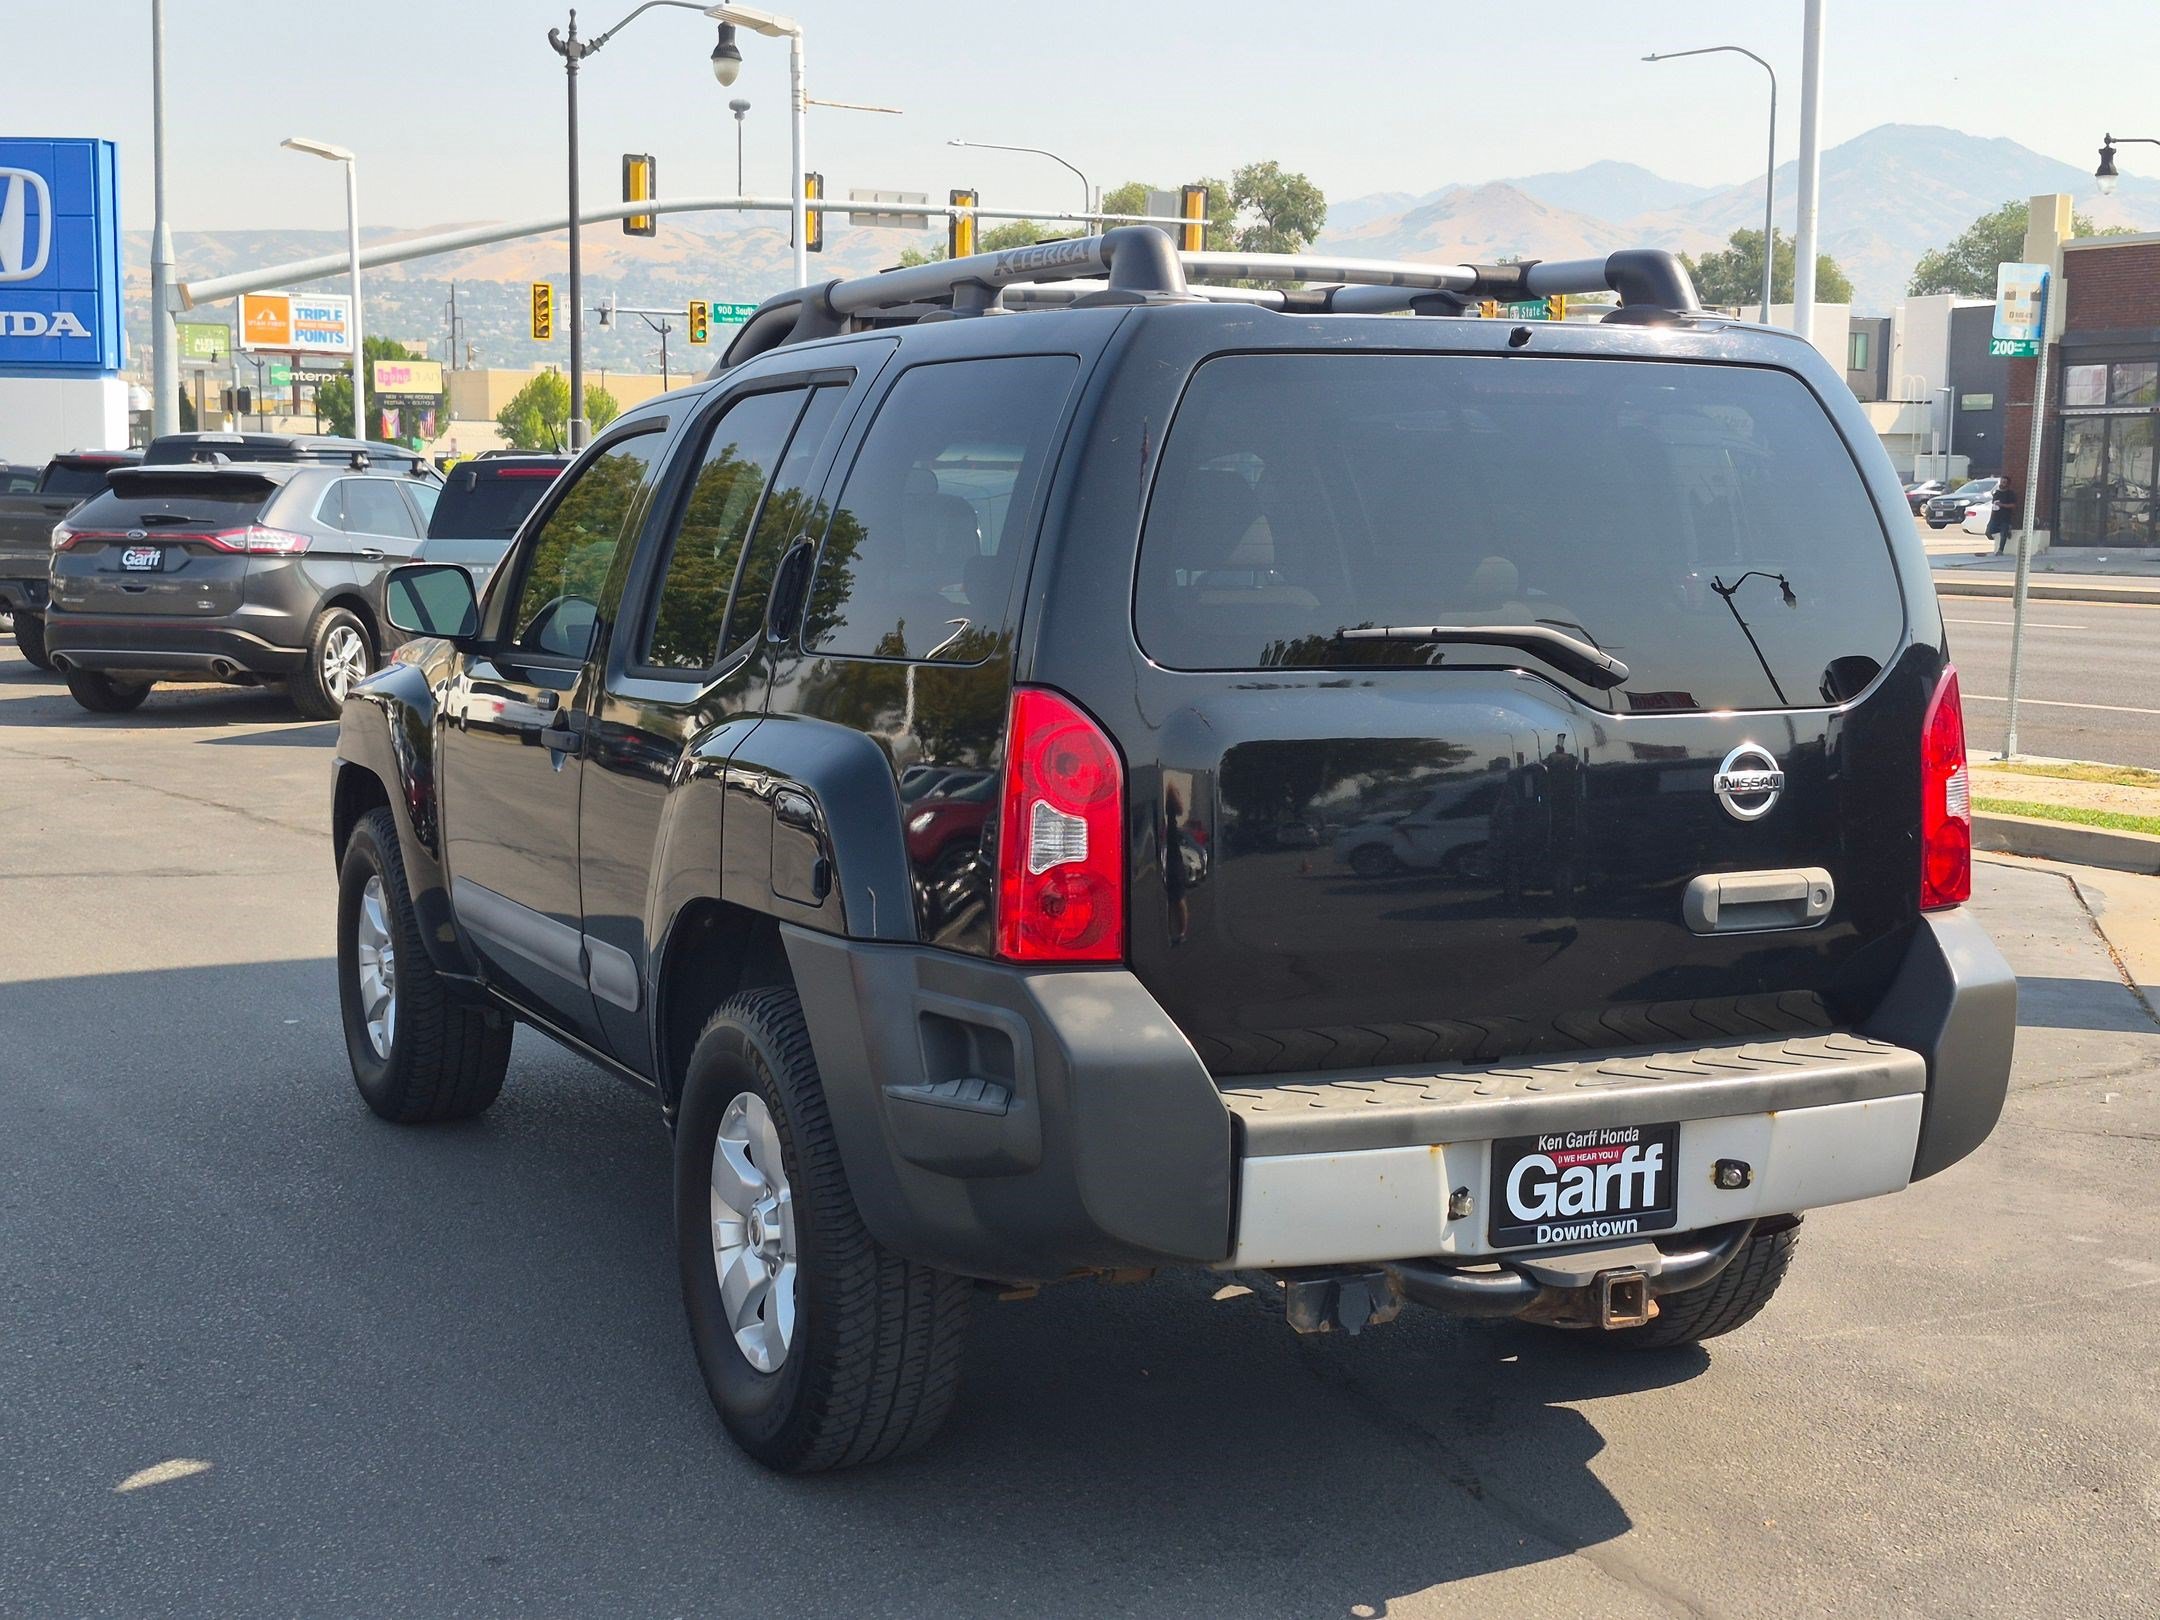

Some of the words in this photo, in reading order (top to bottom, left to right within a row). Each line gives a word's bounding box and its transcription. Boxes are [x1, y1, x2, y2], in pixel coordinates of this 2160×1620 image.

[994, 241, 1088, 276] XTERRA
[295, 307, 343, 321] TRIPLE
[717, 305, 733, 315] 900
[1521, 306, 1541, 318] State
[295, 330, 345, 344] POINTS
[1991, 341, 2015, 355] 200
[122, 550, 161, 566] Garff
[1723, 774, 1780, 791] NISSAN
[1538, 1134, 1562, 1151] Ken
[1565, 1129, 1598, 1149] Garff
[1599, 1126, 1640, 1145] Honda
[1563, 1153, 1576, 1163] WE
[1576, 1152, 1597, 1163] HEAR
[1598, 1151, 1614, 1161] YOU
[1506, 1142, 1664, 1222] Garff
[1536, 1217, 1638, 1244] Downtown
